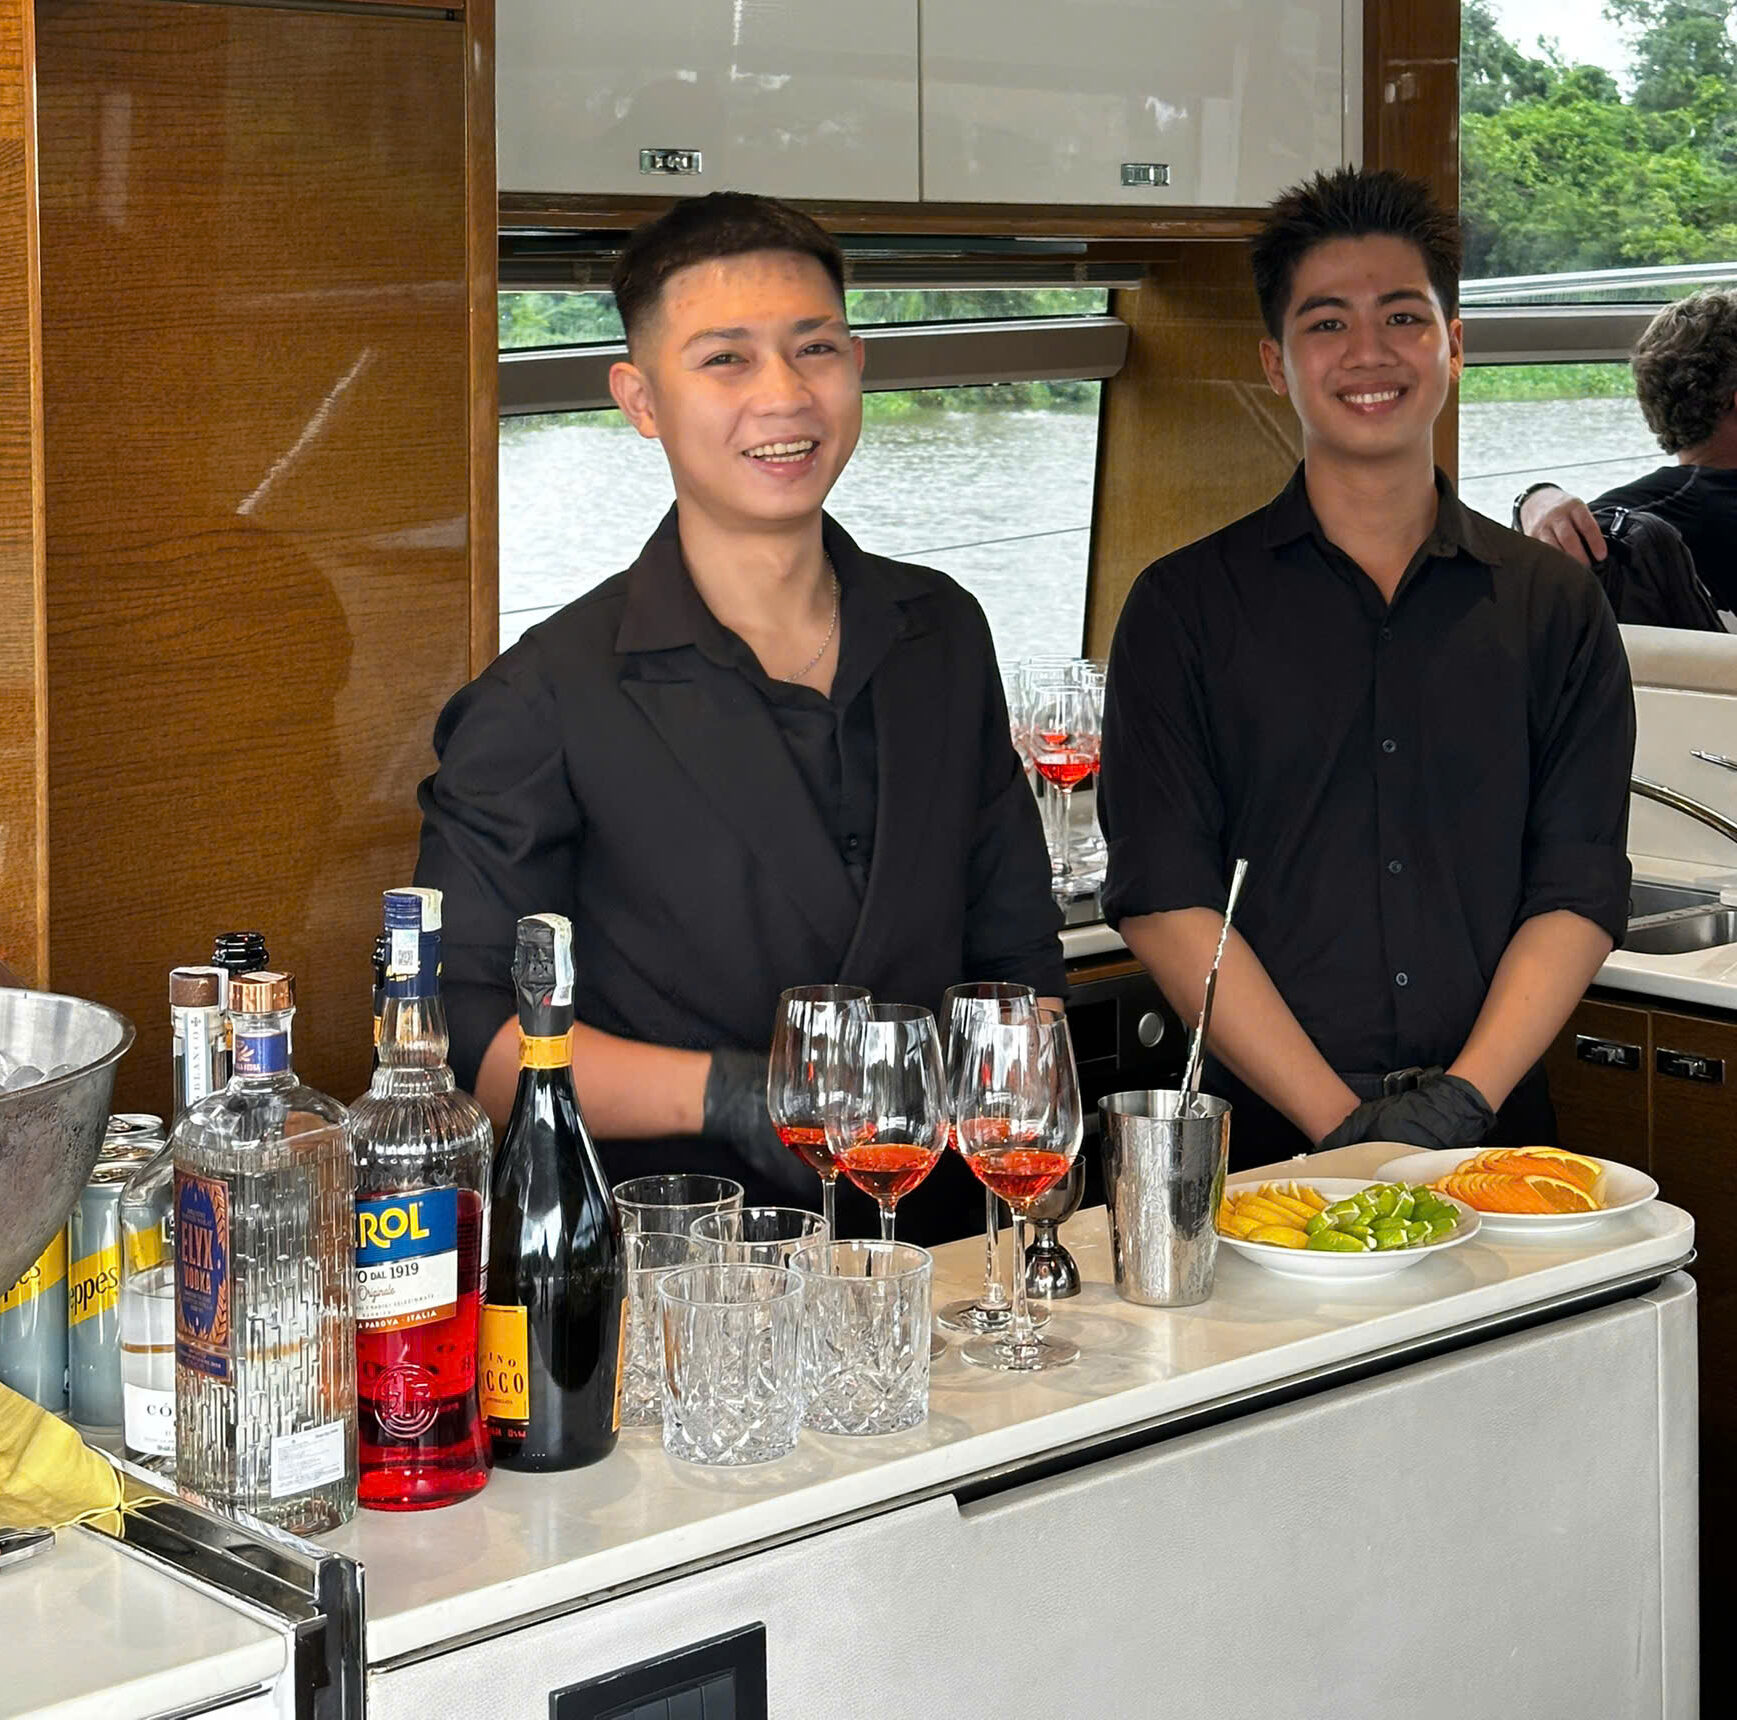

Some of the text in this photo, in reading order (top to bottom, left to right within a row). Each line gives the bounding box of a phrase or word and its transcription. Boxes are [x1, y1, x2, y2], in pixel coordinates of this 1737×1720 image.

[355, 1202, 430, 1249] ROL
[181, 1220, 213, 1271] ELYX
[183, 1263, 212, 1295] VODKA
[370, 1271, 387, 1281] DAL
[390, 1262, 419, 1280] 1919
[406, 1309, 438, 1323] ITALIA
[484, 1352, 517, 1368] INO
[483, 1369, 524, 1394] CCO
